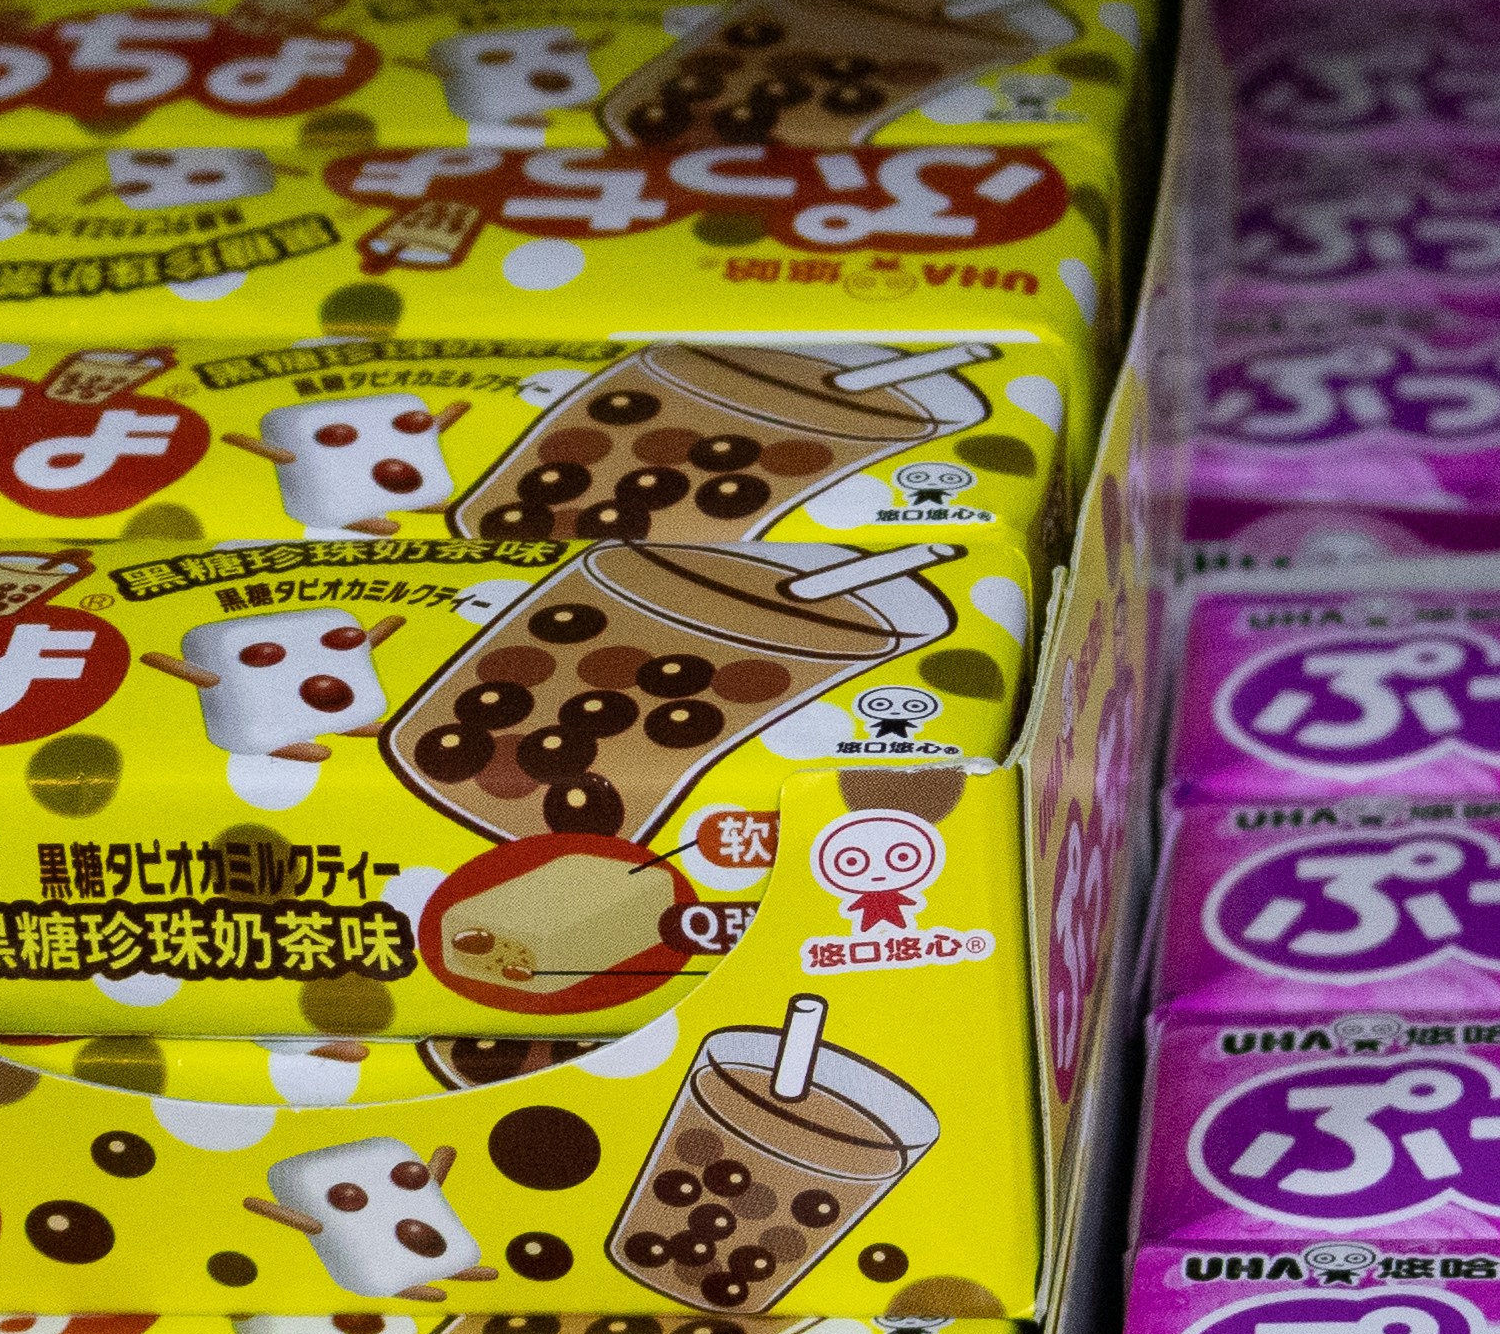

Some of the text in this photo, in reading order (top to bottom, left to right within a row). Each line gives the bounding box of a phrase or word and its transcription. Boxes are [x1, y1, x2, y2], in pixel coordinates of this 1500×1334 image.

[1236, 809, 1337, 828] UHA
[38, 843, 402, 902] 黑糖タピオカミルクティー
[807, 933, 962, 969] 悠口悠心
[1222, 1030, 1328, 1054] UHA
[1185, 1256, 1499, 1282] UHA 悠哈
